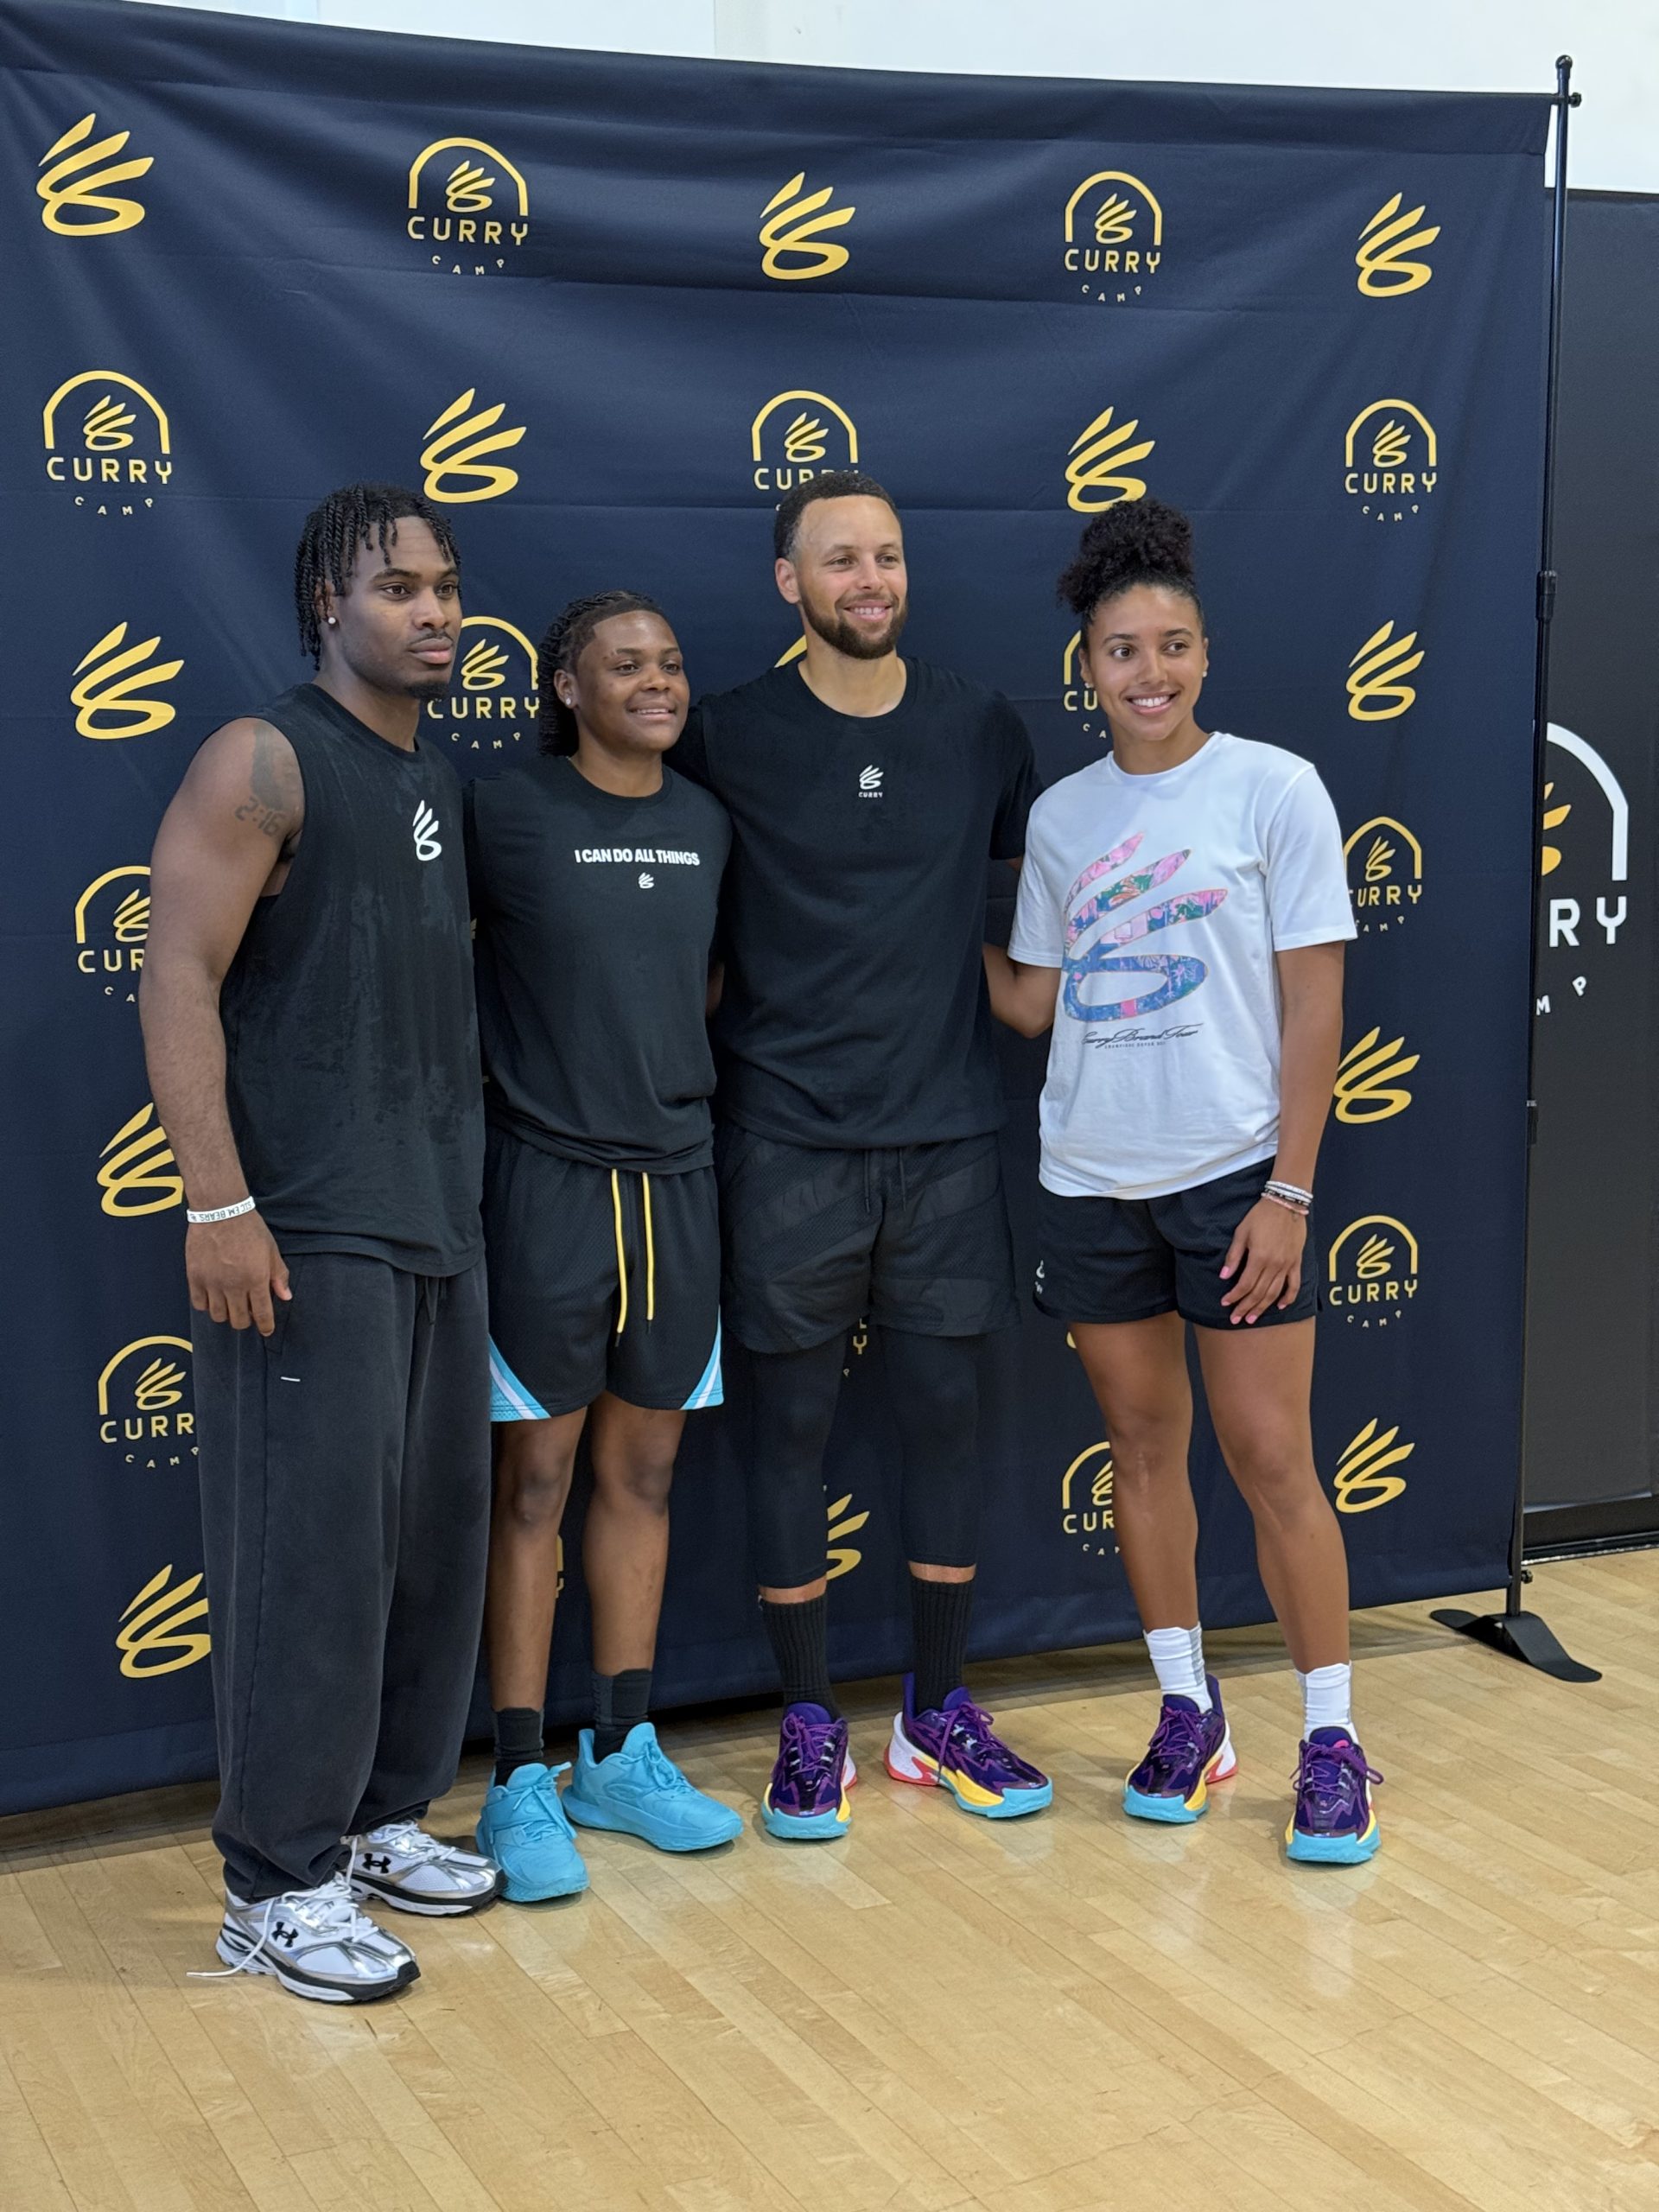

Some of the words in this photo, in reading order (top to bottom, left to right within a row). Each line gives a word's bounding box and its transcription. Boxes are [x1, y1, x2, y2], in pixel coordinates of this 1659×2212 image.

[407, 215, 529, 245] CURRY
[431, 255, 505, 276] CAMP
[1064, 248, 1161, 274] CURRY
[1081, 284, 1141, 302] CAMP
[46, 456, 173, 485] CURRY
[753, 467, 859, 491] CUR
[1344, 472, 1438, 494] CURRY
[74, 496, 154, 516] CAMP
[1362, 505, 1420, 522] CAMP
[427, 696, 540, 719] CURRY
[450, 731, 521, 750] CAMP
[1082, 722, 1107, 739] CA
[574, 849, 582, 863] I
[582, 849, 612, 863] CAN
[613, 848, 633, 863] DO
[634, 849, 656, 863] ALL
[655, 849, 701, 867] THINGS
[1348, 884, 1422, 908] URRY
[77, 948, 145, 974] CUR
[104, 985, 136, 1003] CA
[199, 1211, 226, 1222] BEARS
[1329, 1279, 1418, 1306] CURRY
[1346, 1309, 1402, 1328] CAMP
[99, 1412, 194, 1444] CURR
[124, 1446, 200, 1469] CAMP
[1063, 1510, 1115, 1535] CUR
